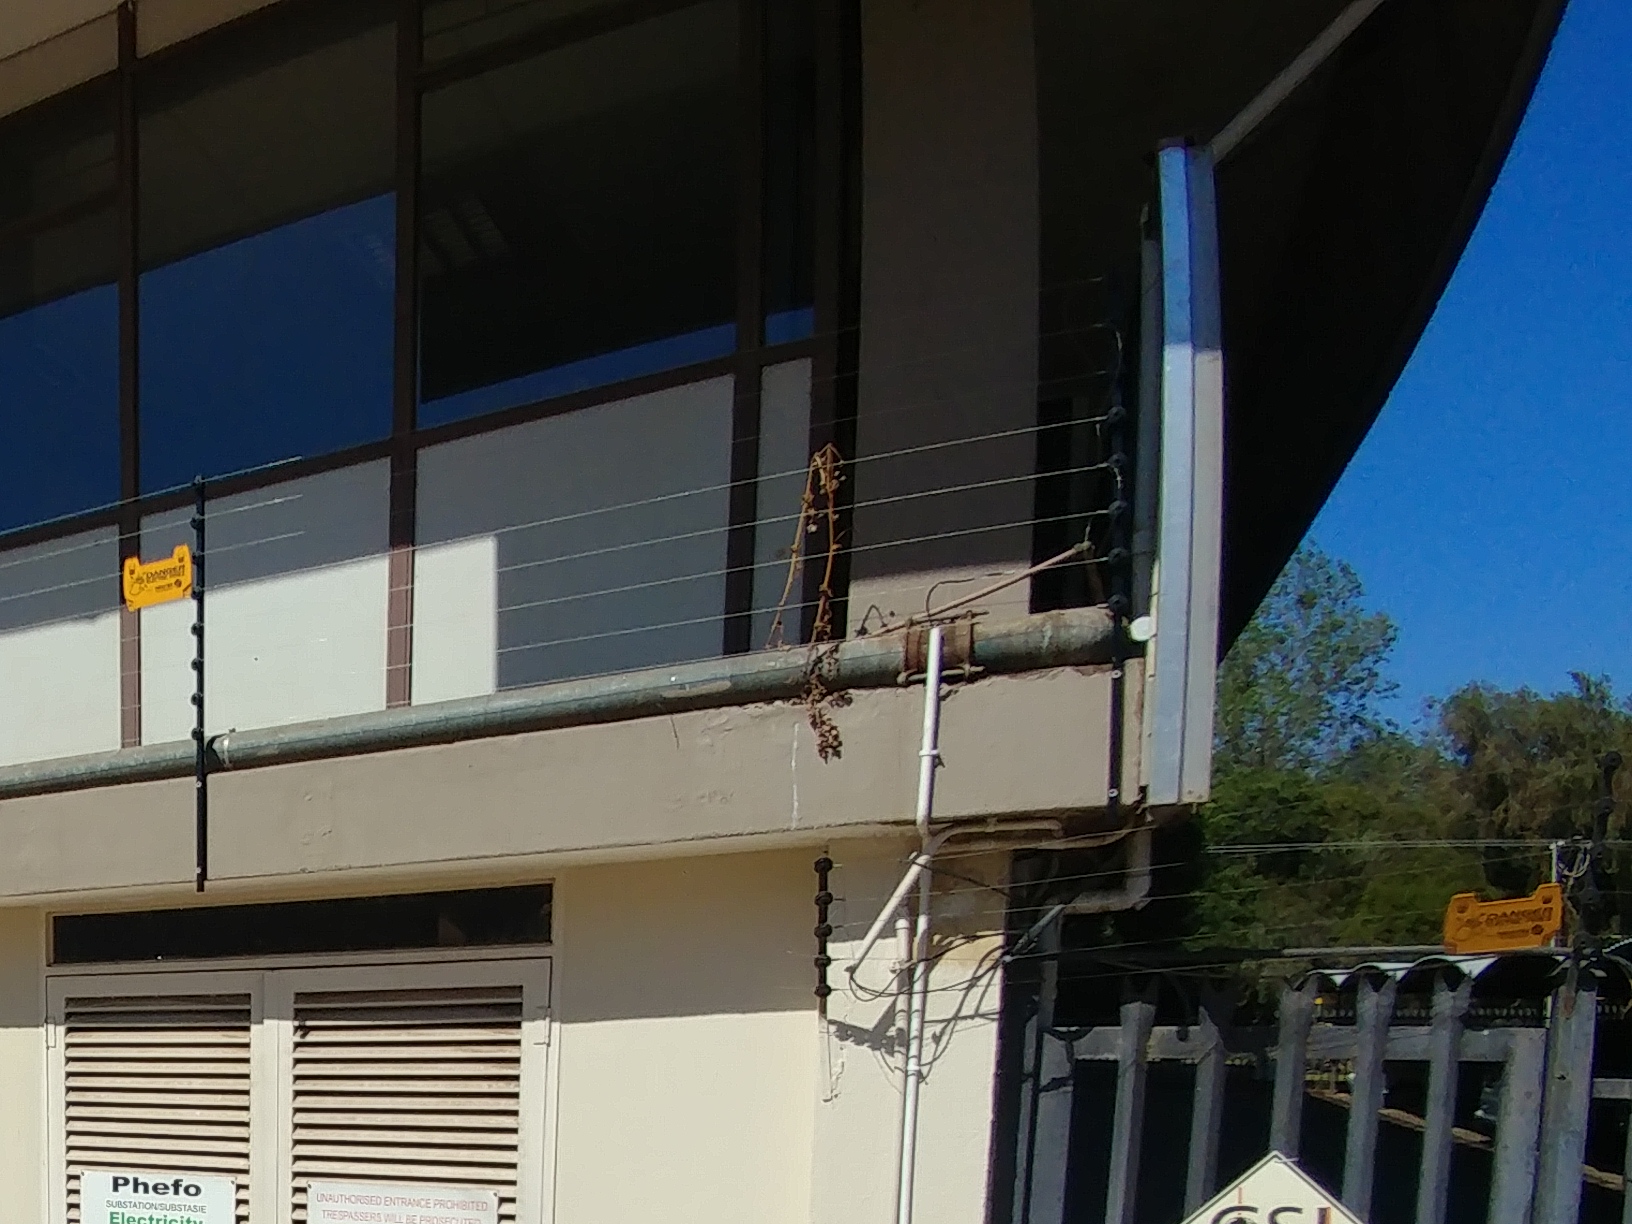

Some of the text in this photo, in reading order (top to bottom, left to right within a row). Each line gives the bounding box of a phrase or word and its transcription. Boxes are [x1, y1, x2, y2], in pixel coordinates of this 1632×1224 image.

[111, 1176, 203, 1197] Phefo
[316, 1193, 488, 1211] UNAUTHORISED ENTRANCE PROHIBITED
[322, 1209, 382, 1222] TRESPASSERS
[384, 1213, 404, 1223] WILL
[405, 1214, 417, 1224] BE
